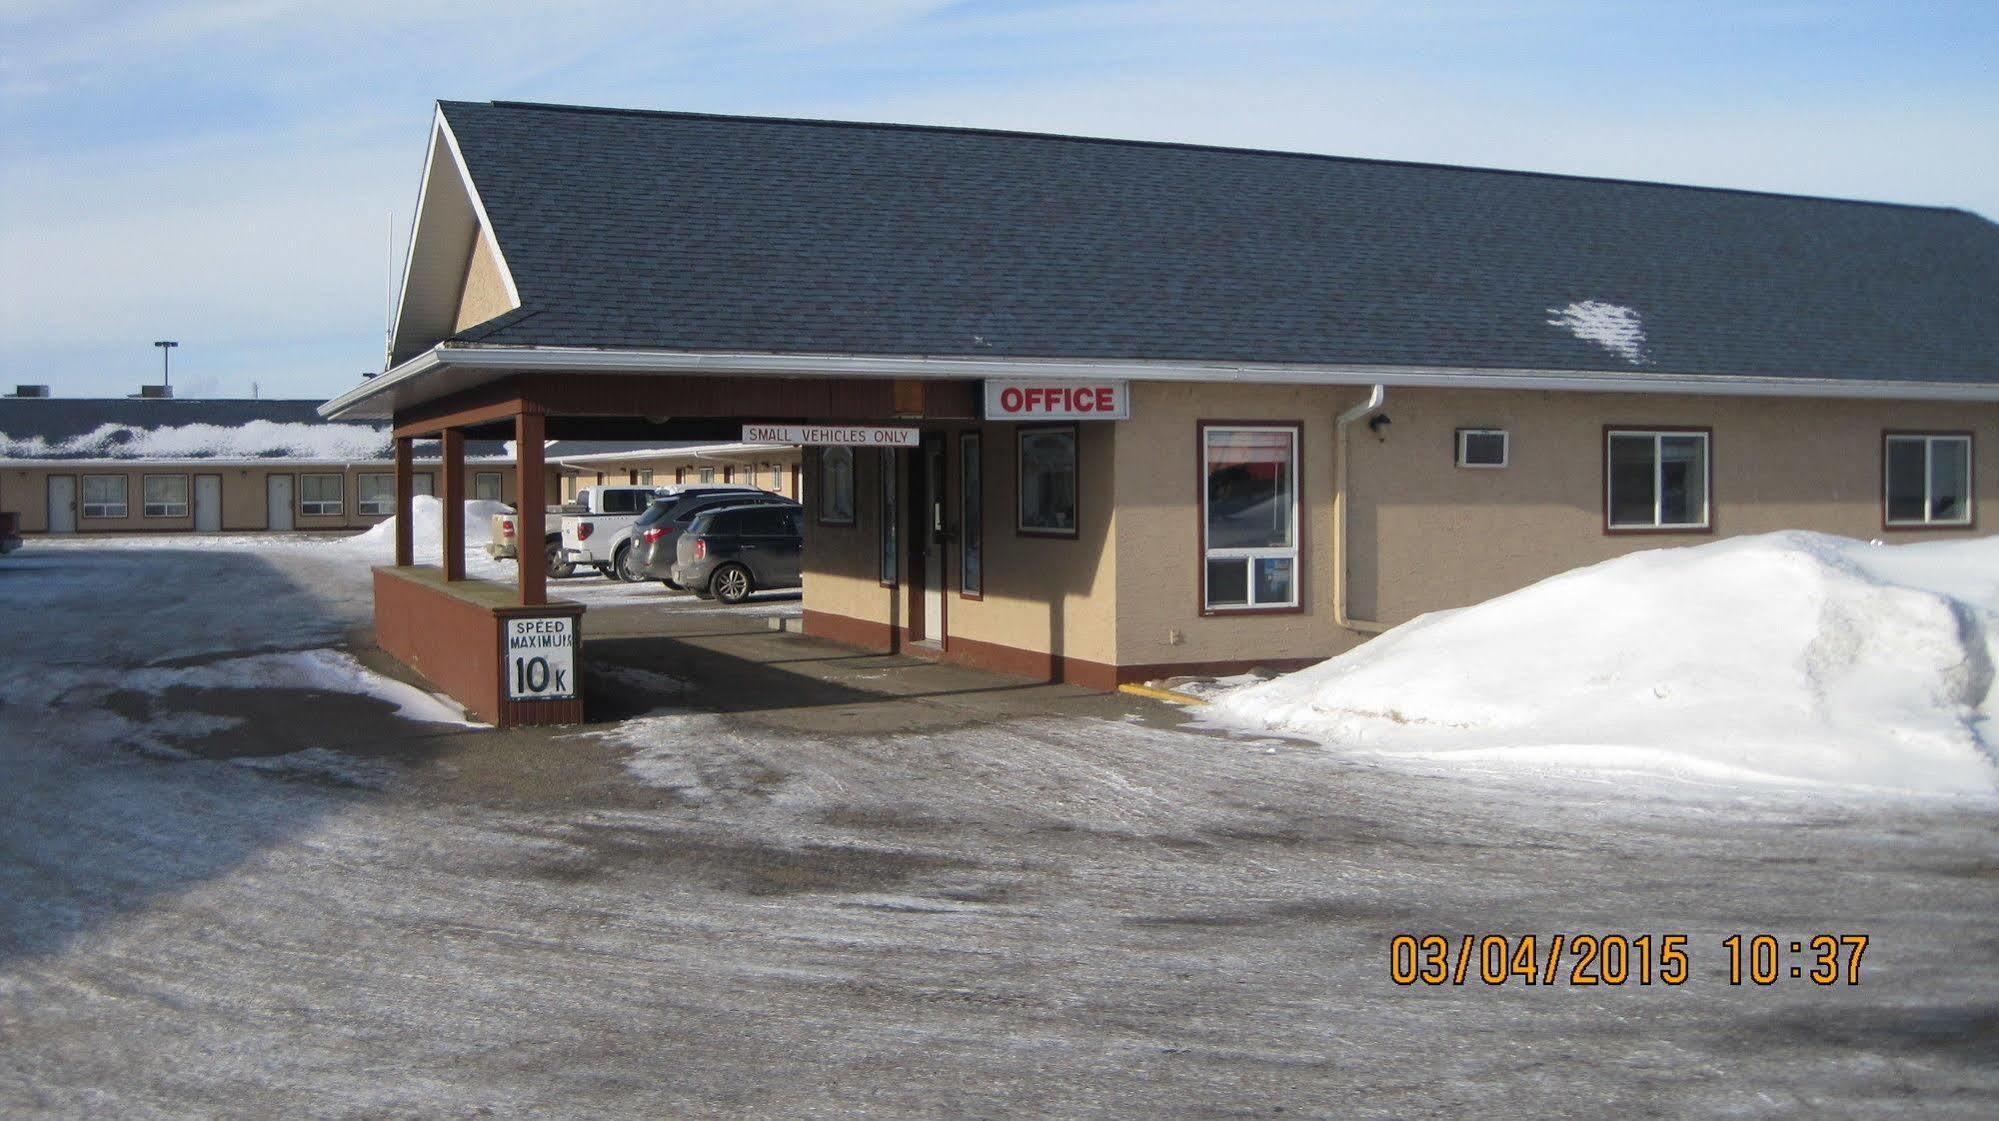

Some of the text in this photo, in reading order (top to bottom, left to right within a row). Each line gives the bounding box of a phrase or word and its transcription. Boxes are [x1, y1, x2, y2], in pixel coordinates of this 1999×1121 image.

[1000, 387, 1115, 413] OFFICE
[749, 427, 908, 443] SMALL VEHICLES ONLY
[517, 621, 565, 634] SPEED
[516, 656, 567, 694] 10 K
